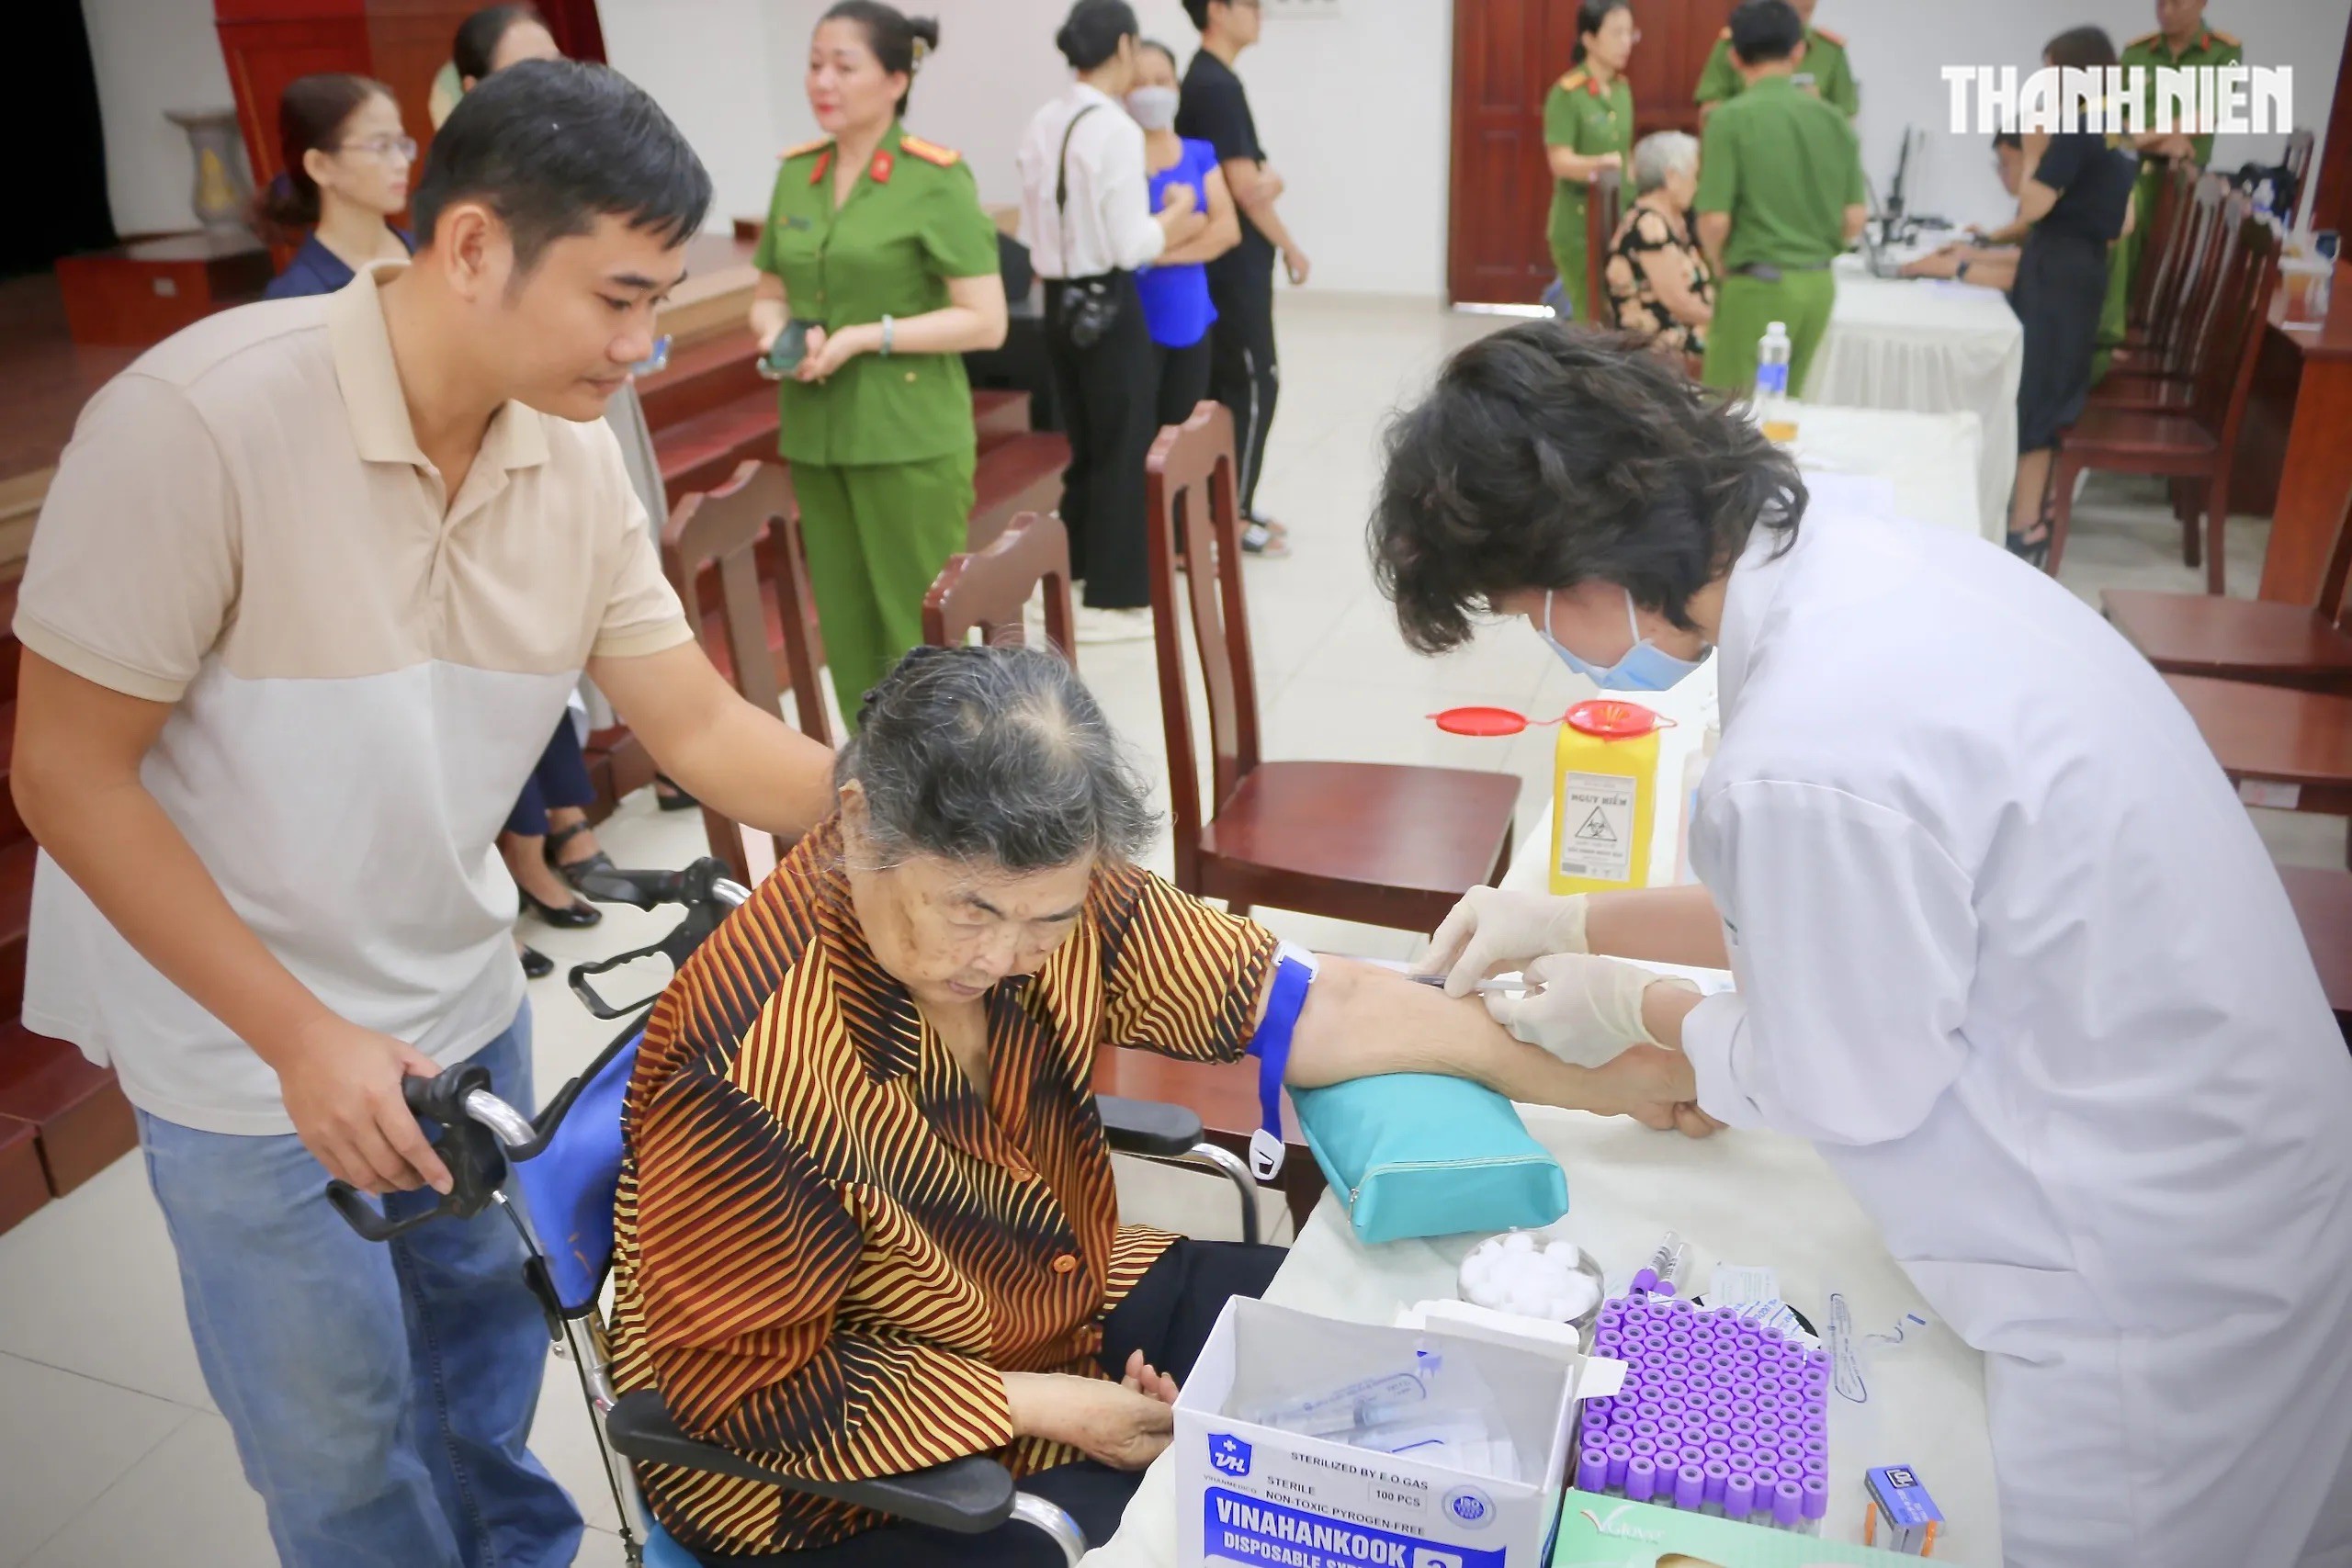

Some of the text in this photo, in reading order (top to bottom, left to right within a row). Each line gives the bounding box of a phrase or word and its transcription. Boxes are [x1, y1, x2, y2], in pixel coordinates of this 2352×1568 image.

[1215, 1452, 1245, 1472] VH
[1291, 1451, 1357, 1474] STERILIZED
[1361, 1468, 1376, 1480] BY
[1267, 1475, 1316, 1495] STERILE
[1376, 1490, 1420, 1507] 100 PCS
[1266, 1490, 1329, 1515] NON-TOXIC
[1332, 1508, 1425, 1537] PYROGEN-FREE
[1216, 1496, 1407, 1568] VINAHANKOOK
[1224, 1531, 1321, 1568] DISPOSABLE
